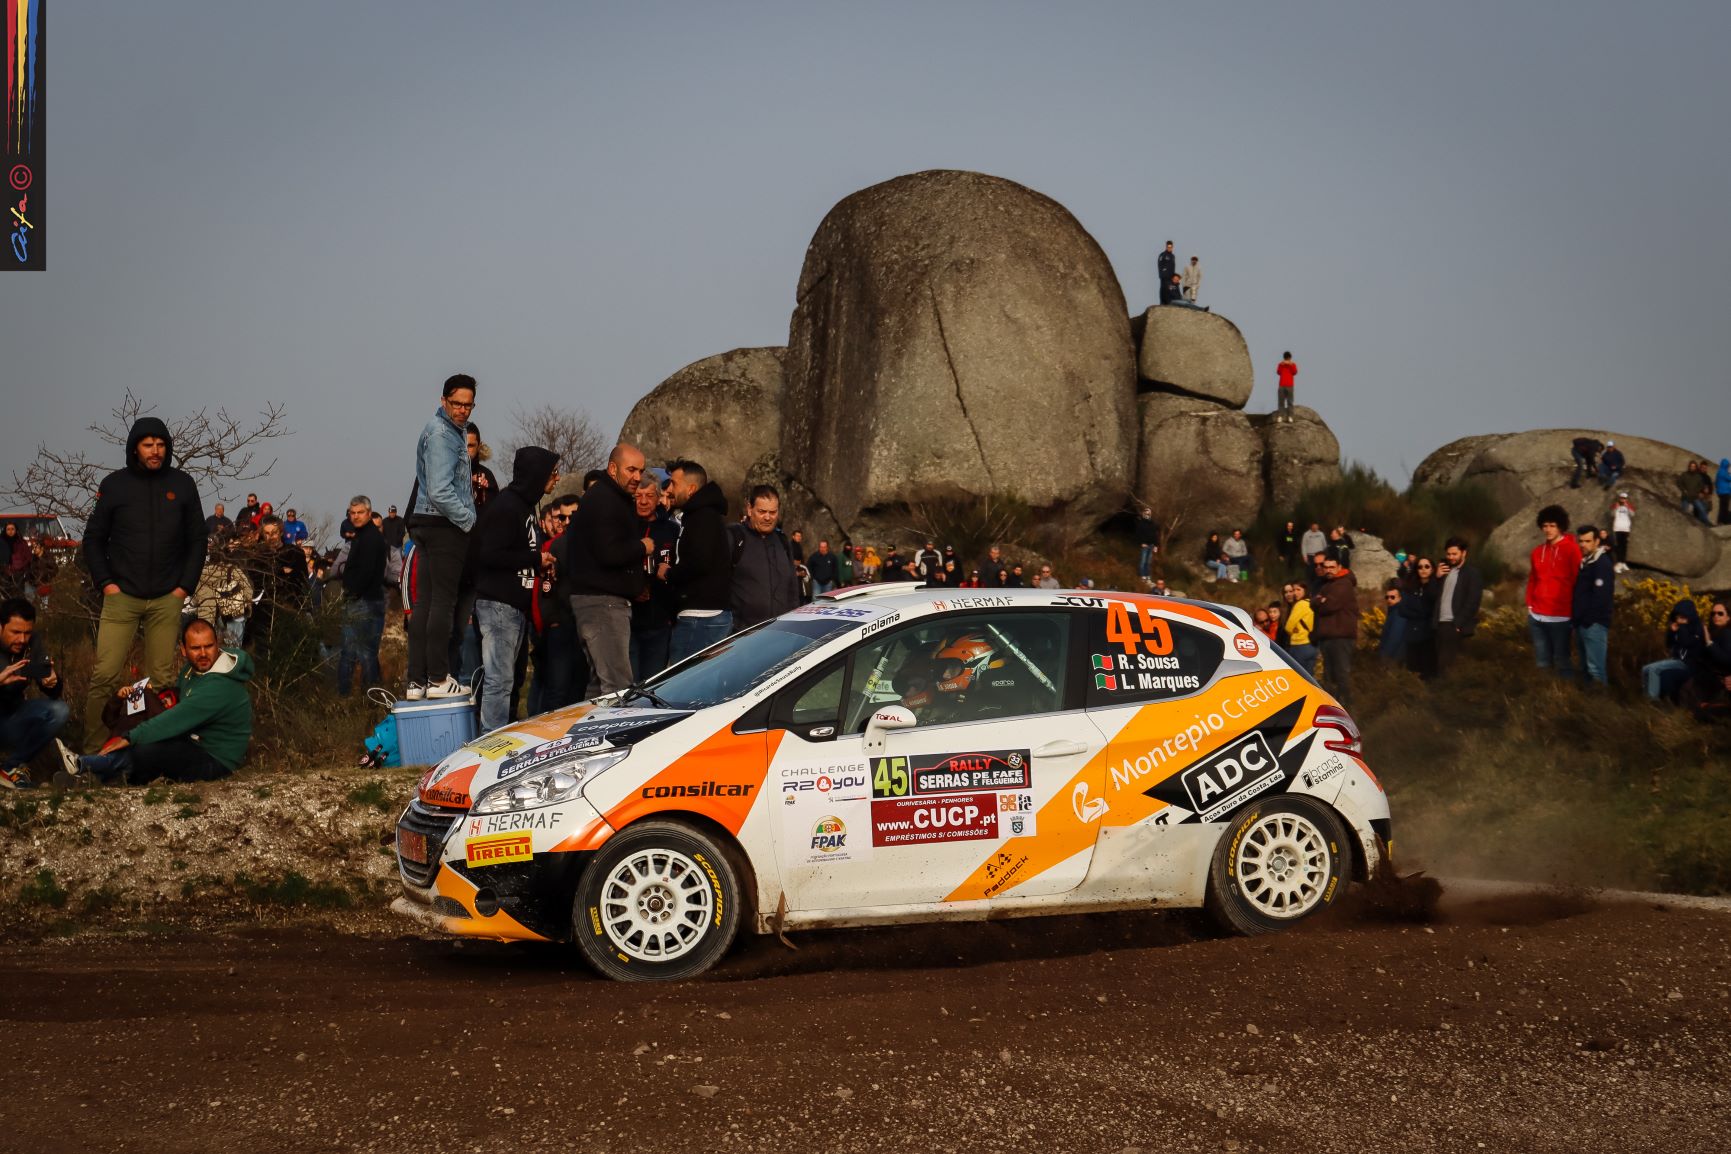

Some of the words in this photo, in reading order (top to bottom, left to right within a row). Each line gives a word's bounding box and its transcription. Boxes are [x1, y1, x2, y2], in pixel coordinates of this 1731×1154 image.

[950, 596, 1014, 609] HERMAF
[861, 612, 901, 640] prolama
[1105, 601, 1174, 656] 45
[1236, 638, 1256, 649] RS
[1117, 654, 1134, 670] R.
[1138, 655, 1180, 670] Sousa
[1121, 674, 1135, 690] L.
[1139, 673, 1200, 692] Marques
[875, 713, 903, 722] TOTAL
[1109, 712, 1225, 791] Montepio
[1221, 675, 1290, 720] Crédito
[500, 752, 548, 777] SERRAS
[781, 763, 865, 777] CHALLENGE
[949, 758, 992, 771] RALLY
[972, 771, 990, 779] DE
[992, 769, 1024, 778] FAFE
[1196, 742, 1269, 804] ADC
[1308, 752, 1339, 778] brand
[1314, 763, 1344, 785] stamina
[873, 757, 909, 797] 45
[919, 772, 969, 789] SERRAS
[981, 776, 1024, 786] FELGUEIRAS
[642, 781, 755, 799] consilcar
[941, 796, 974, 804] PENHORES
[1204, 810, 1221, 823] Aços
[1222, 801, 1238, 813] Duro
[1238, 793, 1248, 802] da
[1248, 782, 1270, 796] Costa,
[1270, 773, 1283, 784] Lda
[487, 812, 564, 833] HERMAF
[876, 805, 996, 831] www.CUCP.pt
[810, 834, 848, 850] FPAK
[885, 832, 937, 842] EMPRÉSTIMOS
[946, 828, 989, 838] COMISSÕES
[1228, 812, 1259, 877] SCORPION
[466, 836, 532, 862] PIRELLI
[693, 853, 724, 928] SCORPION
